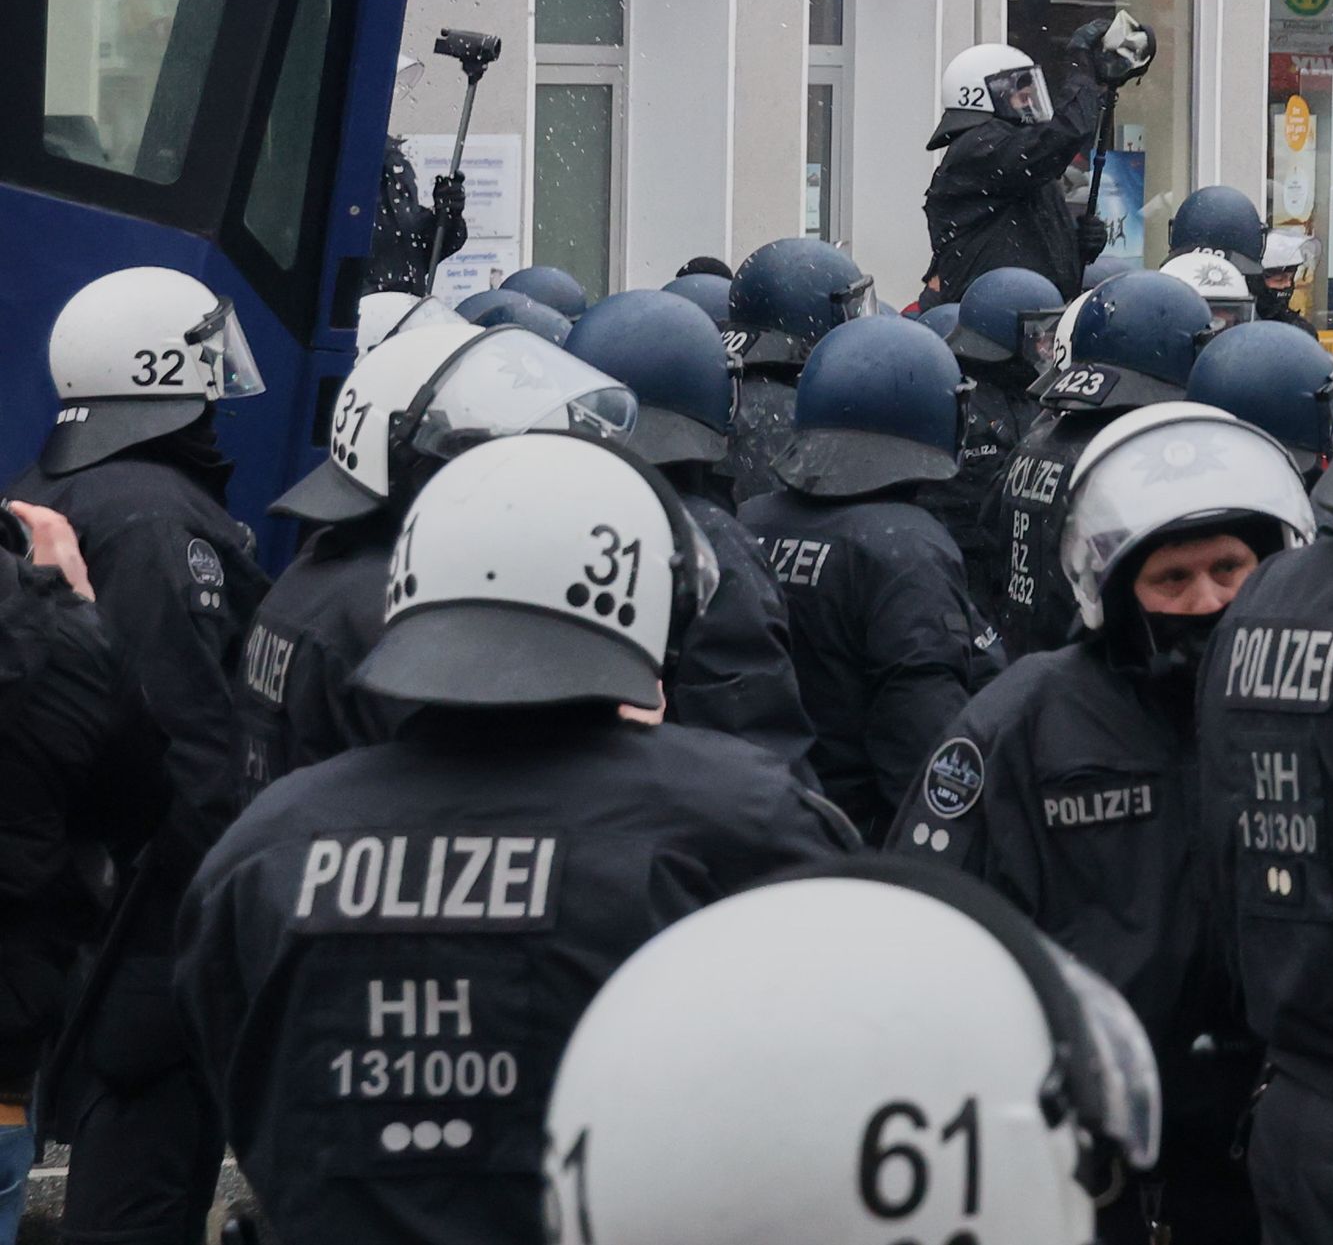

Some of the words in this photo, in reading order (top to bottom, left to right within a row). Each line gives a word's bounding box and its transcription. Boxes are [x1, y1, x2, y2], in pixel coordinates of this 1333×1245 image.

[957, 85, 985, 108] 32
[131, 348, 186, 387] 32
[1054, 370, 1105, 396] 423
[336, 388, 373, 447] 31
[1003, 456, 1065, 505] POLIZEI
[1012, 509, 1031, 541] BP
[583, 523, 642, 597] 31
[758, 537, 832, 587] IZEI
[1011, 541, 1029, 574] RZ
[1251, 751, 1300, 802] HH
[1044, 783, 1152, 826] POLIZEI
[297, 836, 556, 919] POLIZEI
[367, 980, 471, 1038] HH
[329, 1050, 518, 1097] 131000
[857, 1096, 983, 1220] 61
